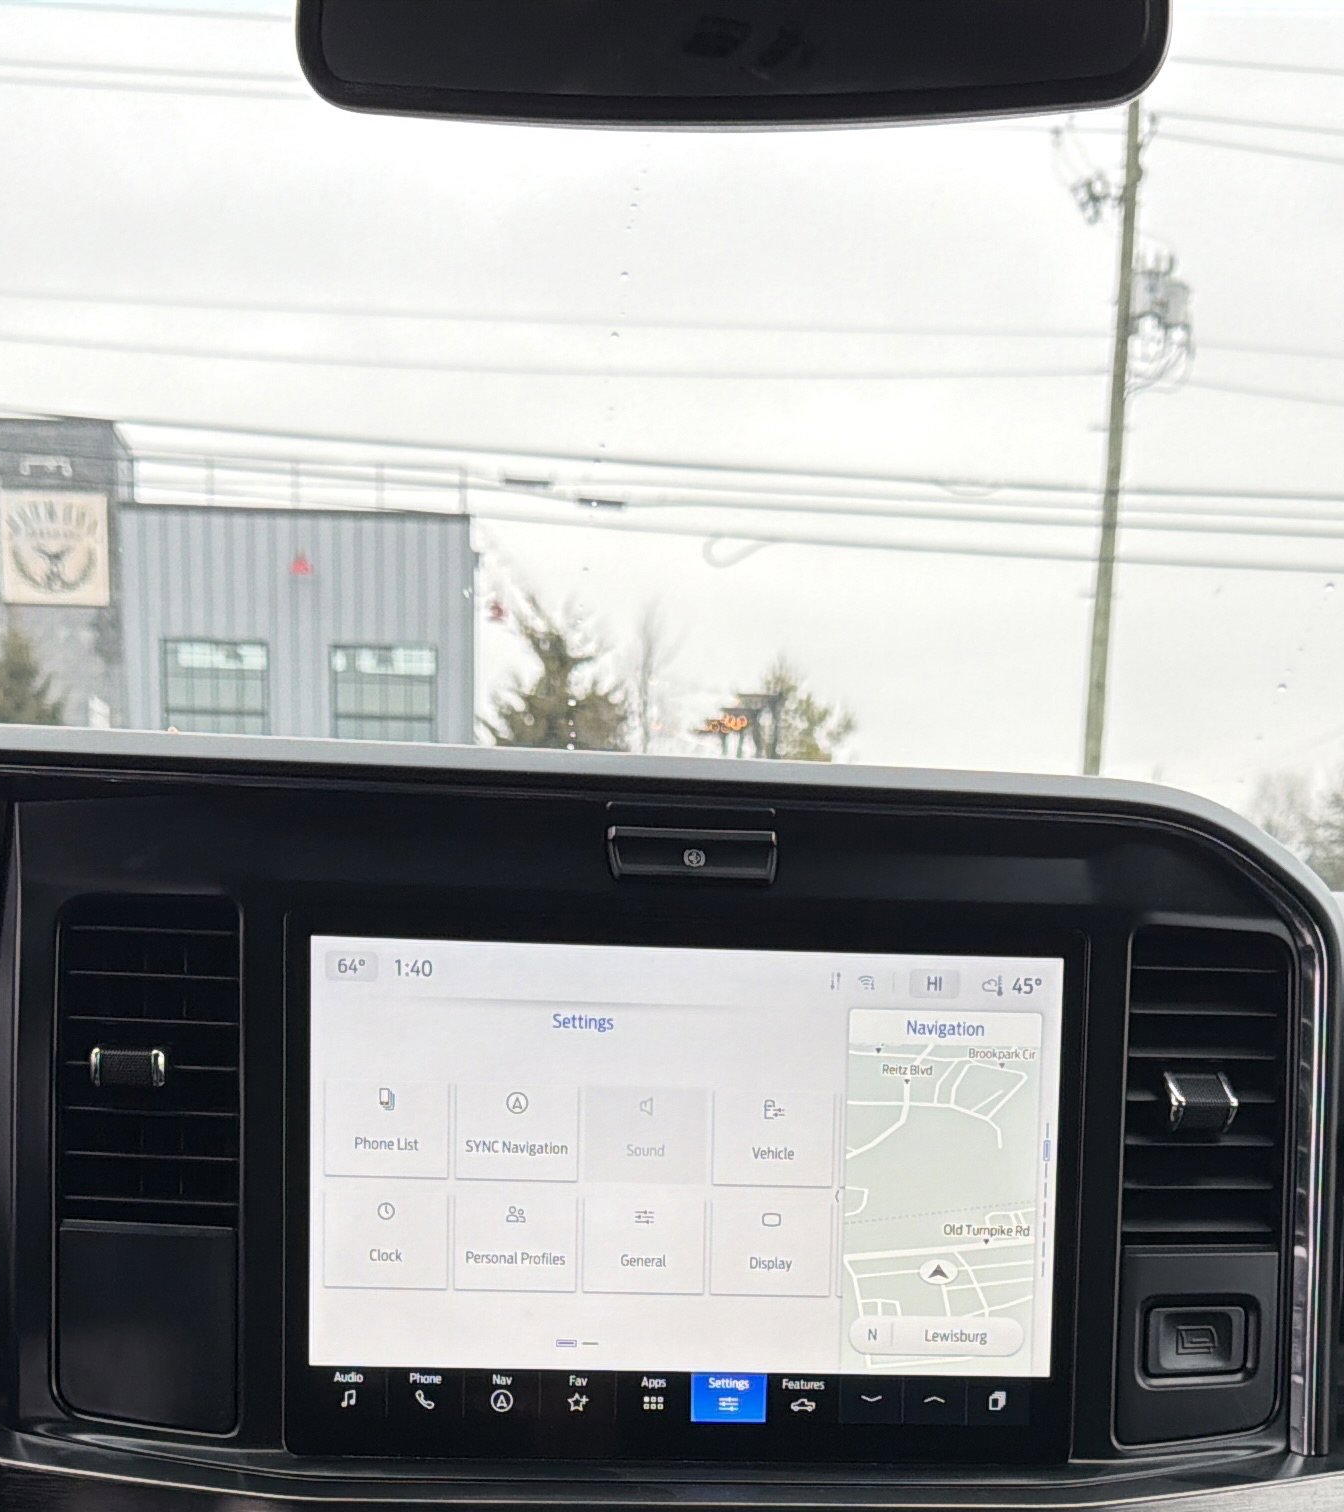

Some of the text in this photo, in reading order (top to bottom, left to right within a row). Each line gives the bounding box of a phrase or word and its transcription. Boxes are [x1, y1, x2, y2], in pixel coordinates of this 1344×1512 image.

[337, 958, 366, 975] 64°
[394, 958, 433, 978] 1:40
[926, 975, 943, 992] HI
[1012, 976, 1043, 995] 45°
[552, 1013, 615, 1033] Settings
[906, 1019, 986, 1038] Navigation
[968, 1047, 1037, 1061] Brookpark Cir
[882, 1064, 934, 1076] Reitz Blvd
[354, 1136, 420, 1152] Phone List
[465, 1139, 569, 1157] SYNC Navigation
[626, 1143, 666, 1158] Sound
[752, 1146, 795, 1161] Vehicle
[943, 1223, 1031, 1238] Old Turnpike Rd
[369, 1248, 403, 1263] Clock
[465, 1250, 566, 1266] Personal Profiles
[620, 1253, 667, 1268] General
[749, 1256, 793, 1272] Display
[867, 1328, 878, 1341] N
[924, 1329, 988, 1346] Lewisburg
[333, 1371, 364, 1383] Audio
[409, 1372, 443, 1385] Phone
[492, 1374, 513, 1386] Nav
[569, 1375, 589, 1387] Fav
[641, 1376, 667, 1389] Apps
[708, 1377, 750, 1390] Settings
[782, 1378, 826, 1390] Features
